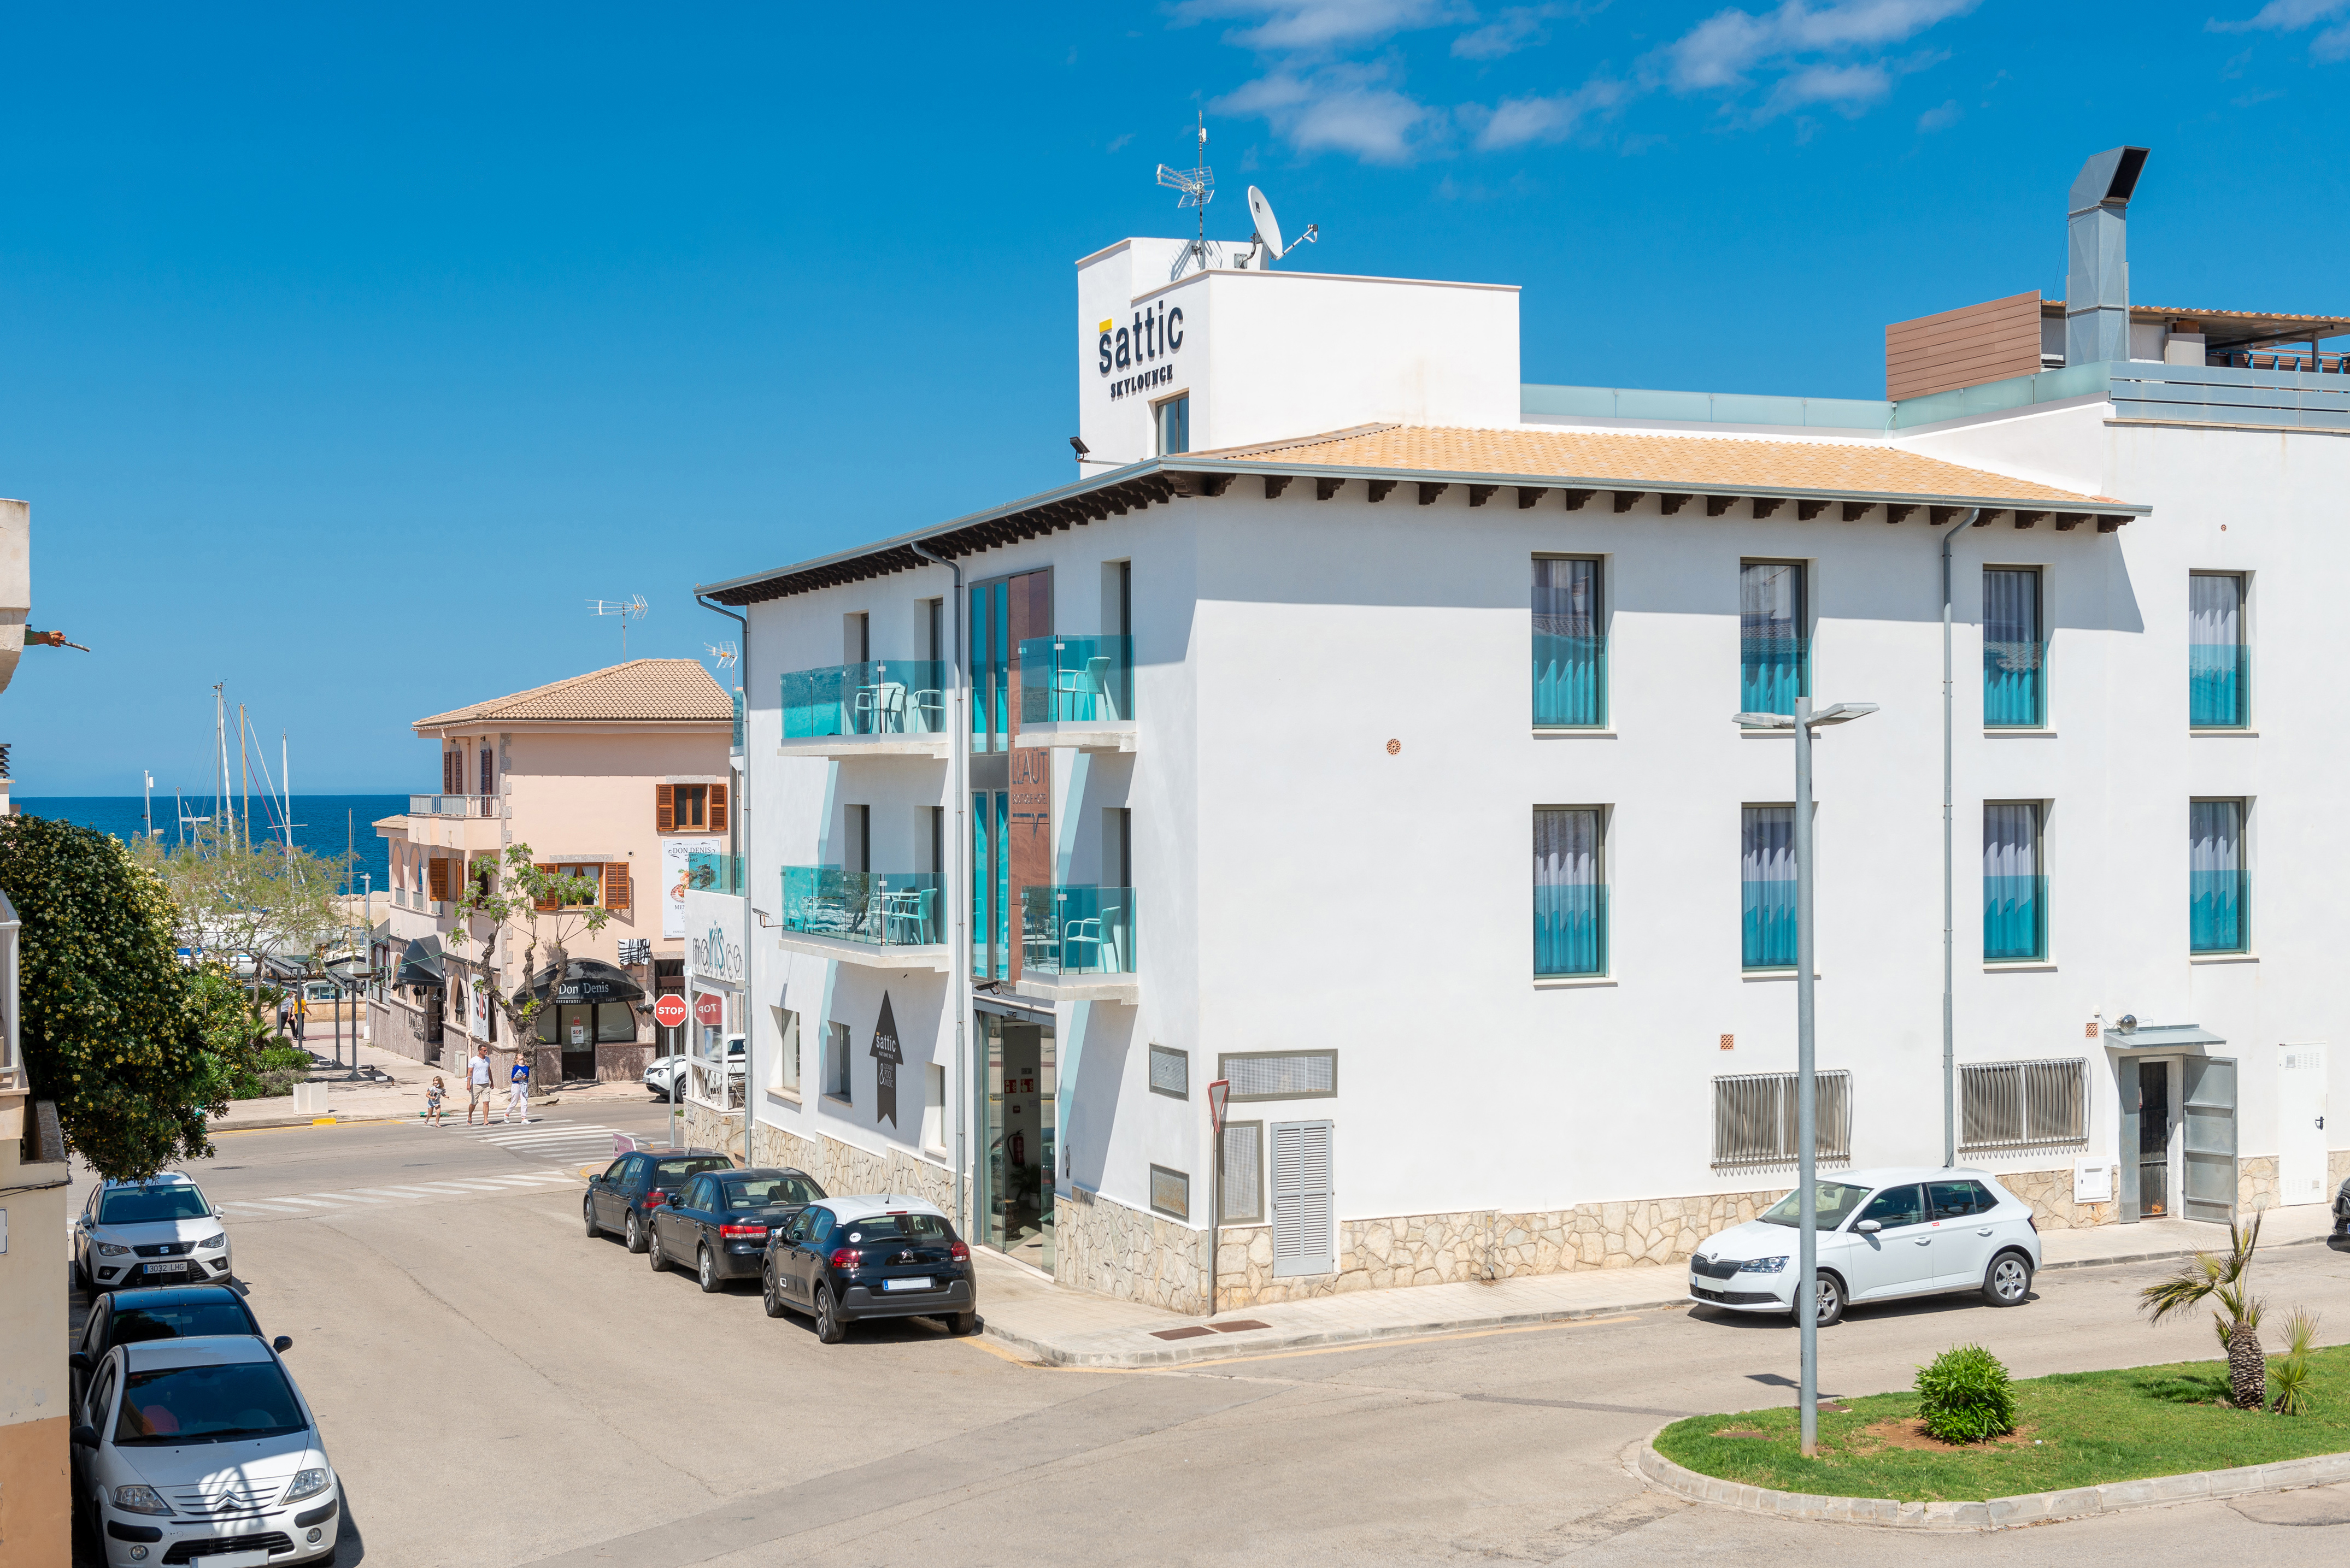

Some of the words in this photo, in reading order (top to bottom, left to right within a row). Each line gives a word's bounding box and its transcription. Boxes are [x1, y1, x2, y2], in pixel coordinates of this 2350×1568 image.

[1099, 300, 1183, 374] sattic
[1111, 364, 1173, 398] SKYLOUNGE
[1013, 794, 1033, 804] BOUTIQUE
[1034, 793, 1048, 804] HOTEL
[559, 983, 579, 994] Don
[583, 981, 609, 994] Denis
[658, 1006, 684, 1015] STOP
[876, 1034, 896, 1052] sattic
[149, 1264, 167, 1272] 3032
[171, 1263, 184, 1271] LHG
